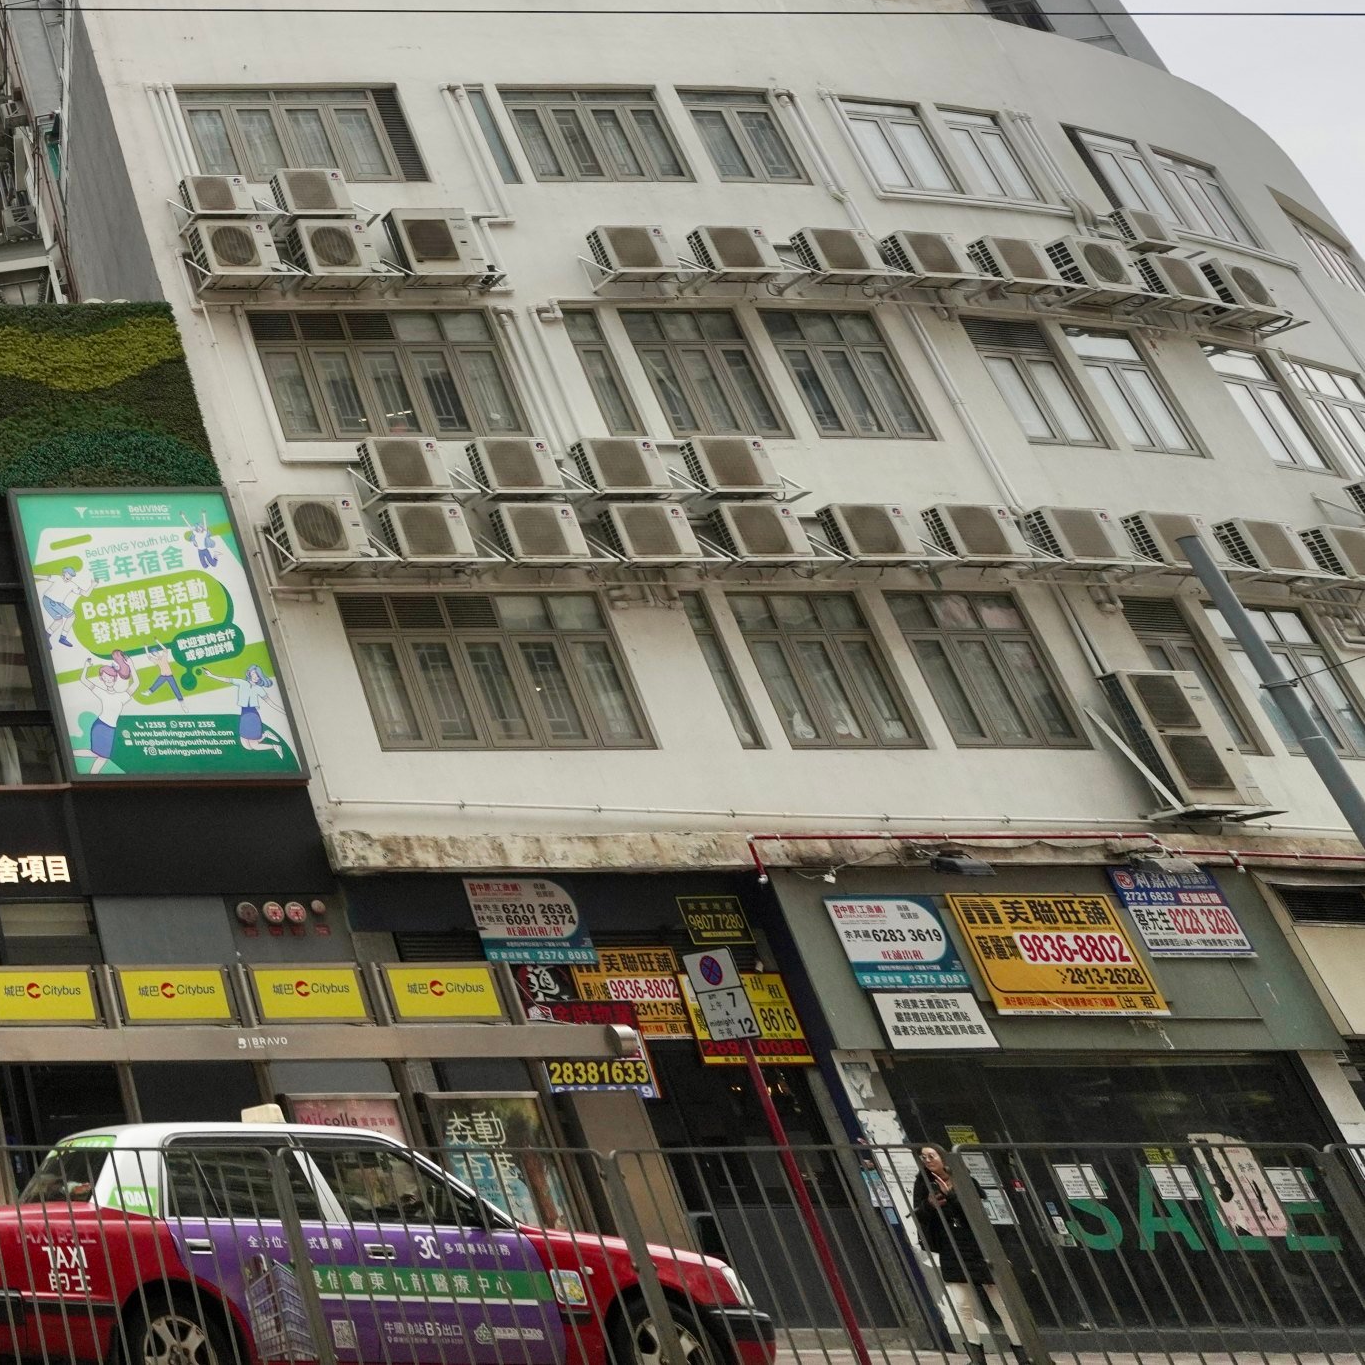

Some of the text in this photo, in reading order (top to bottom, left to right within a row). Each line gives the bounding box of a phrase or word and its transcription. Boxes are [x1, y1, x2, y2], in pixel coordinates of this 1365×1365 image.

[85, 534, 180, 558] BeLIVING Youth Hub
[89, 545, 184, 582] 青年宿舍
[91, 601, 214, 644] 發揮青年力量
[144, 721, 167, 729] 12355
[1123, 891, 1175, 901] 2721 6833
[501, 903, 573, 915] 6210 2638
[1000, 899, 1111, 926] 美聯旺舖
[505, 914, 576, 926] 6091 3374
[1167, 907, 1240, 935] 8228 3260
[871, 928, 943, 942] 6283 3619
[537, 951, 565, 960] 2576
[567, 951, 595, 960] 8081
[1019, 934, 1132, 963] 9836-8802
[601, 953, 674, 973] 美聯旺舖
[909, 974, 936, 984] 2576
[939, 974, 967, 984] 8081
[1067, 967, 1144, 985] 2813-2628
[4, 985, 81, 997] 城巴 Citybus
[138, 984, 216, 997] 城巴 Citybus
[272, 982, 350, 995] 城巴 Citybus
[407, 982, 485, 995] 城巴 Citybus
[609, 977, 680, 999] 9836-8802
[726, 991, 737, 1008] 7
[709, 1017, 736, 1028] midnight
[737, 1016, 757, 1035] 12
[759, 1007, 797, 1032] 8616
[252, 1036, 288, 1047] BRAVO
[549, 1061, 649, 1084] 28381633
[300, 1112, 358, 1127] Milcolla
[1066, 1166, 1343, 1252] SALE
[41, 1246, 89, 1269] TAXI
[48, 1269, 92, 1292] 的士
